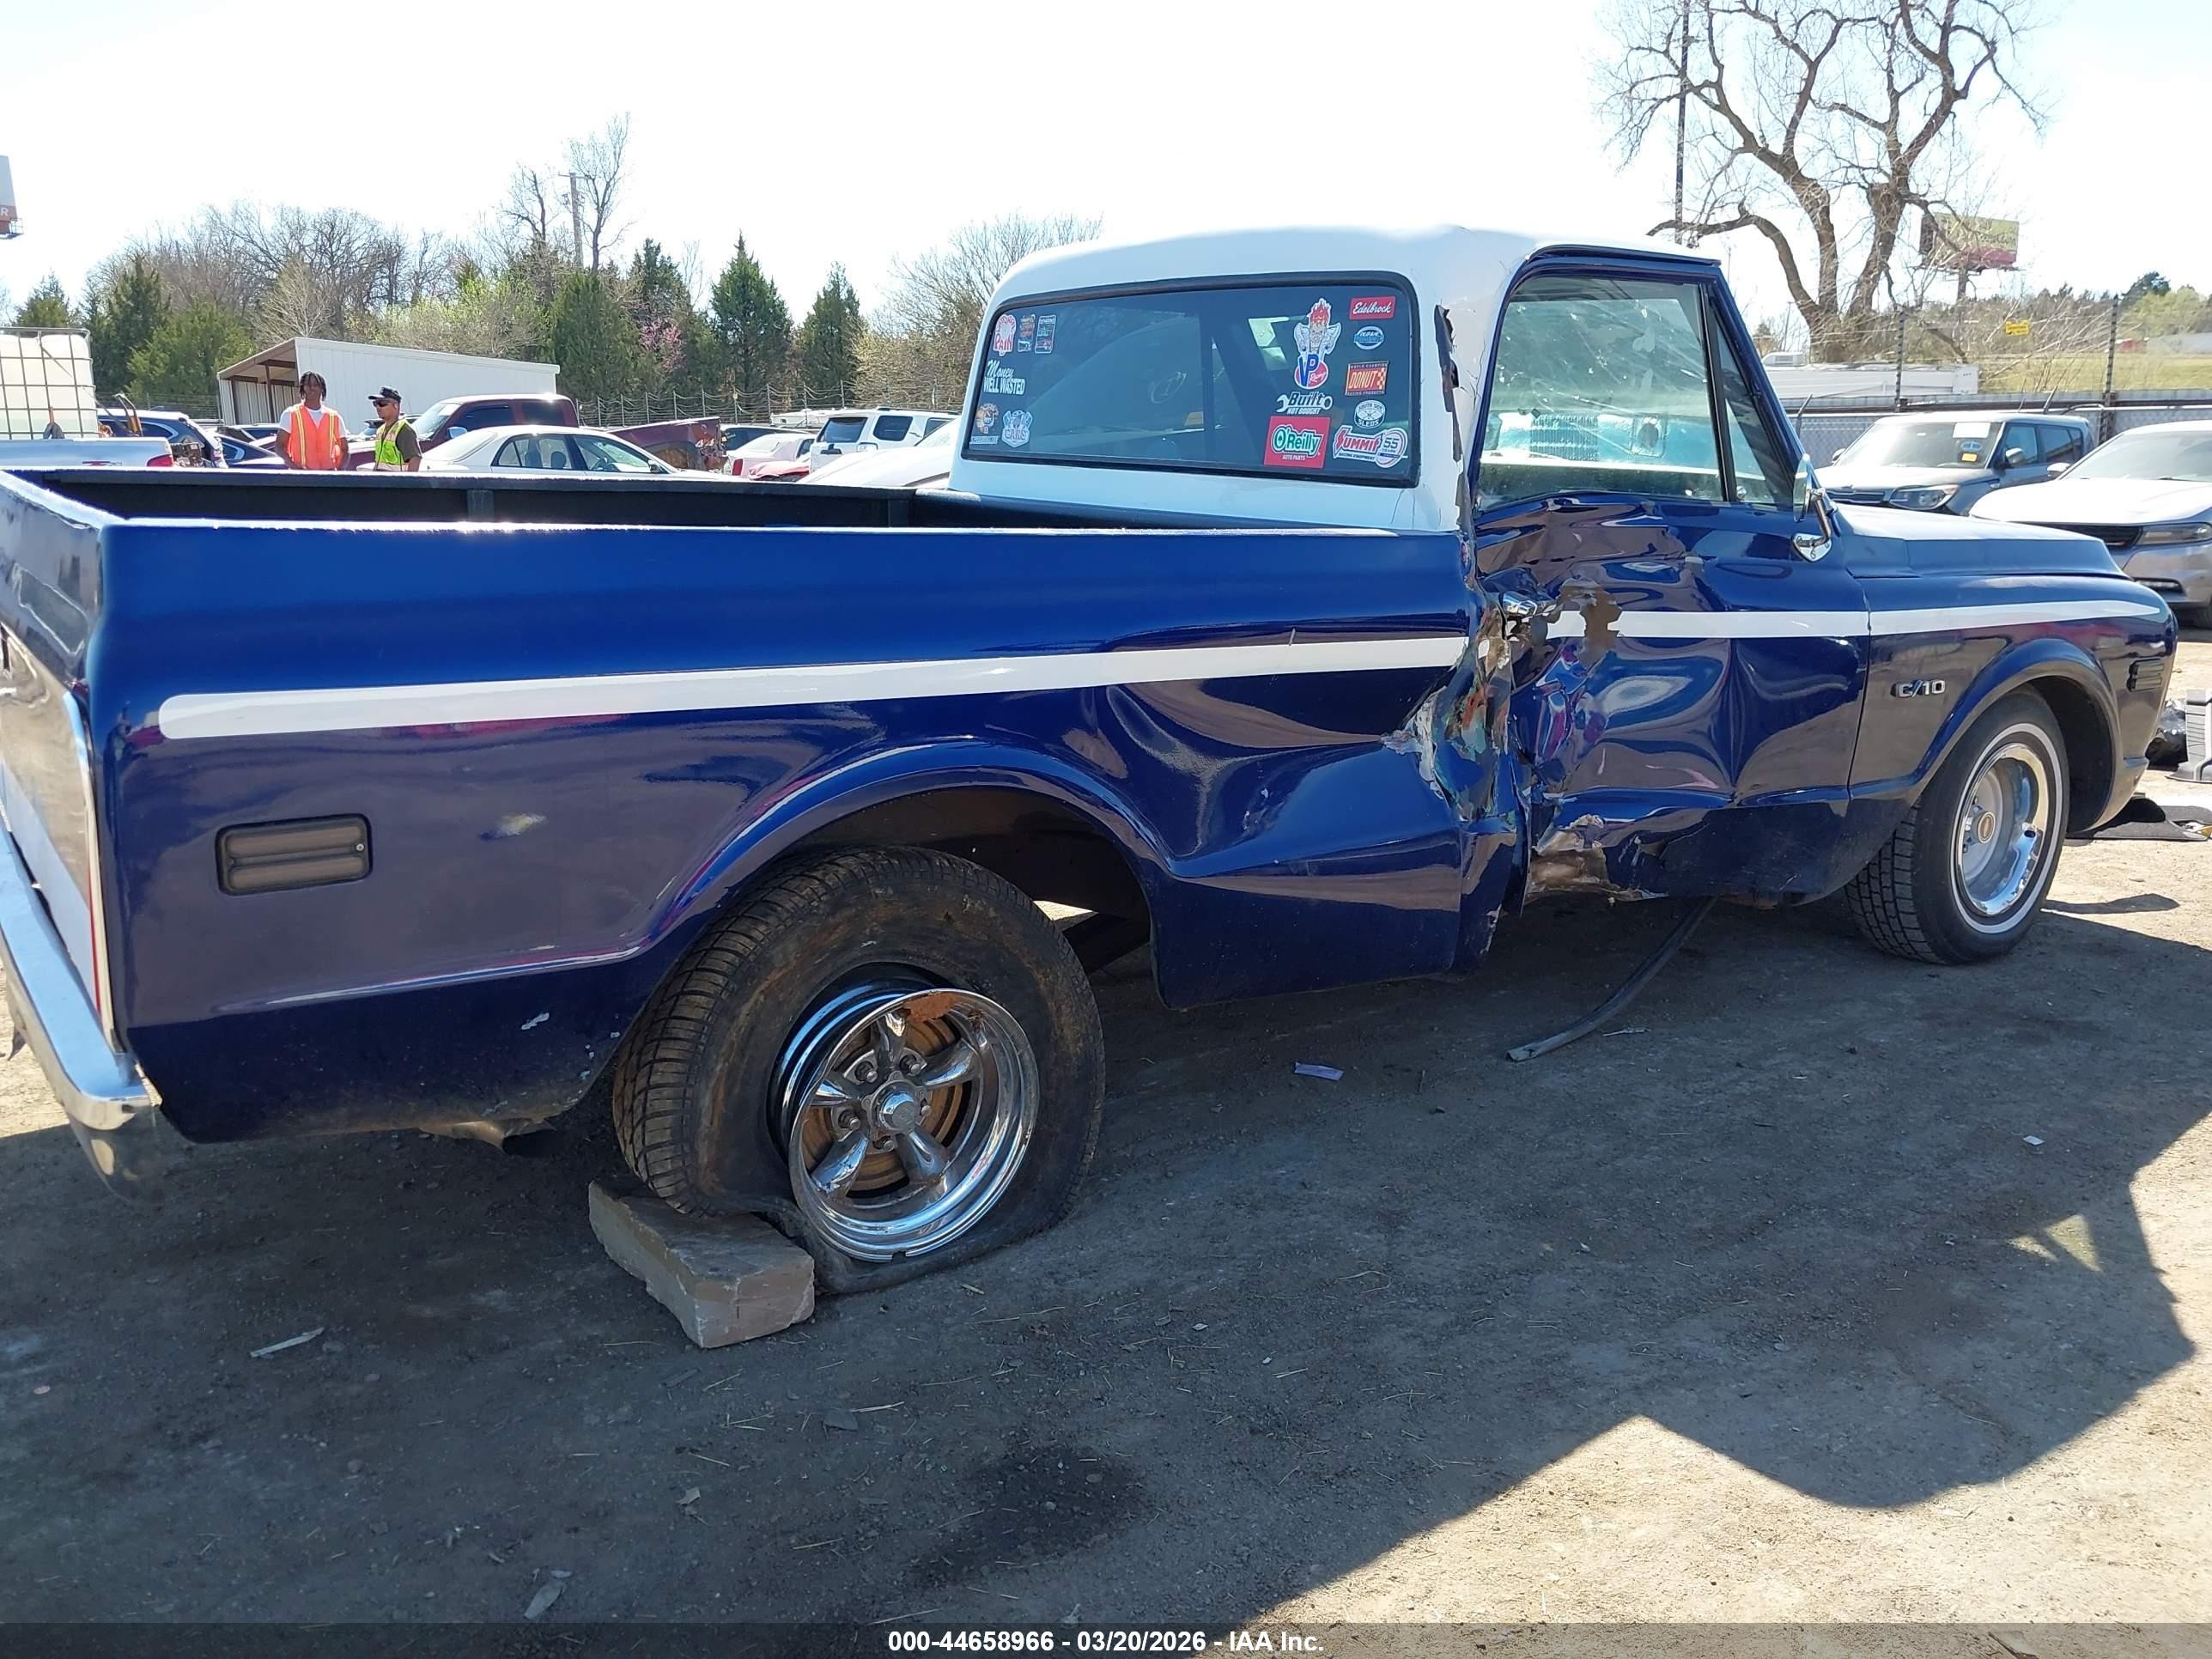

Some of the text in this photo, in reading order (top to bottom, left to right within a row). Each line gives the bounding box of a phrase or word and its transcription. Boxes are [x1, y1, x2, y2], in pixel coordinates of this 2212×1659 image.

[1352, 301, 1393, 315] Edelbrock
[994, 333, 1013, 351] PAIN
[987, 359, 1015, 379] Money
[1298, 353, 1321, 387] VP
[983, 376, 1026, 396] WELL WASTED
[1348, 370, 1378, 389] DONUT
[1288, 392, 1324, 406] Built
[1358, 418, 1379, 427] SLEDS
[1273, 427, 1320, 453] O'Reilly
[1335, 429, 1381, 452] SUMMIT
[1383, 437, 1400, 449] 55
[1898, 679, 1946, 698] C/10
